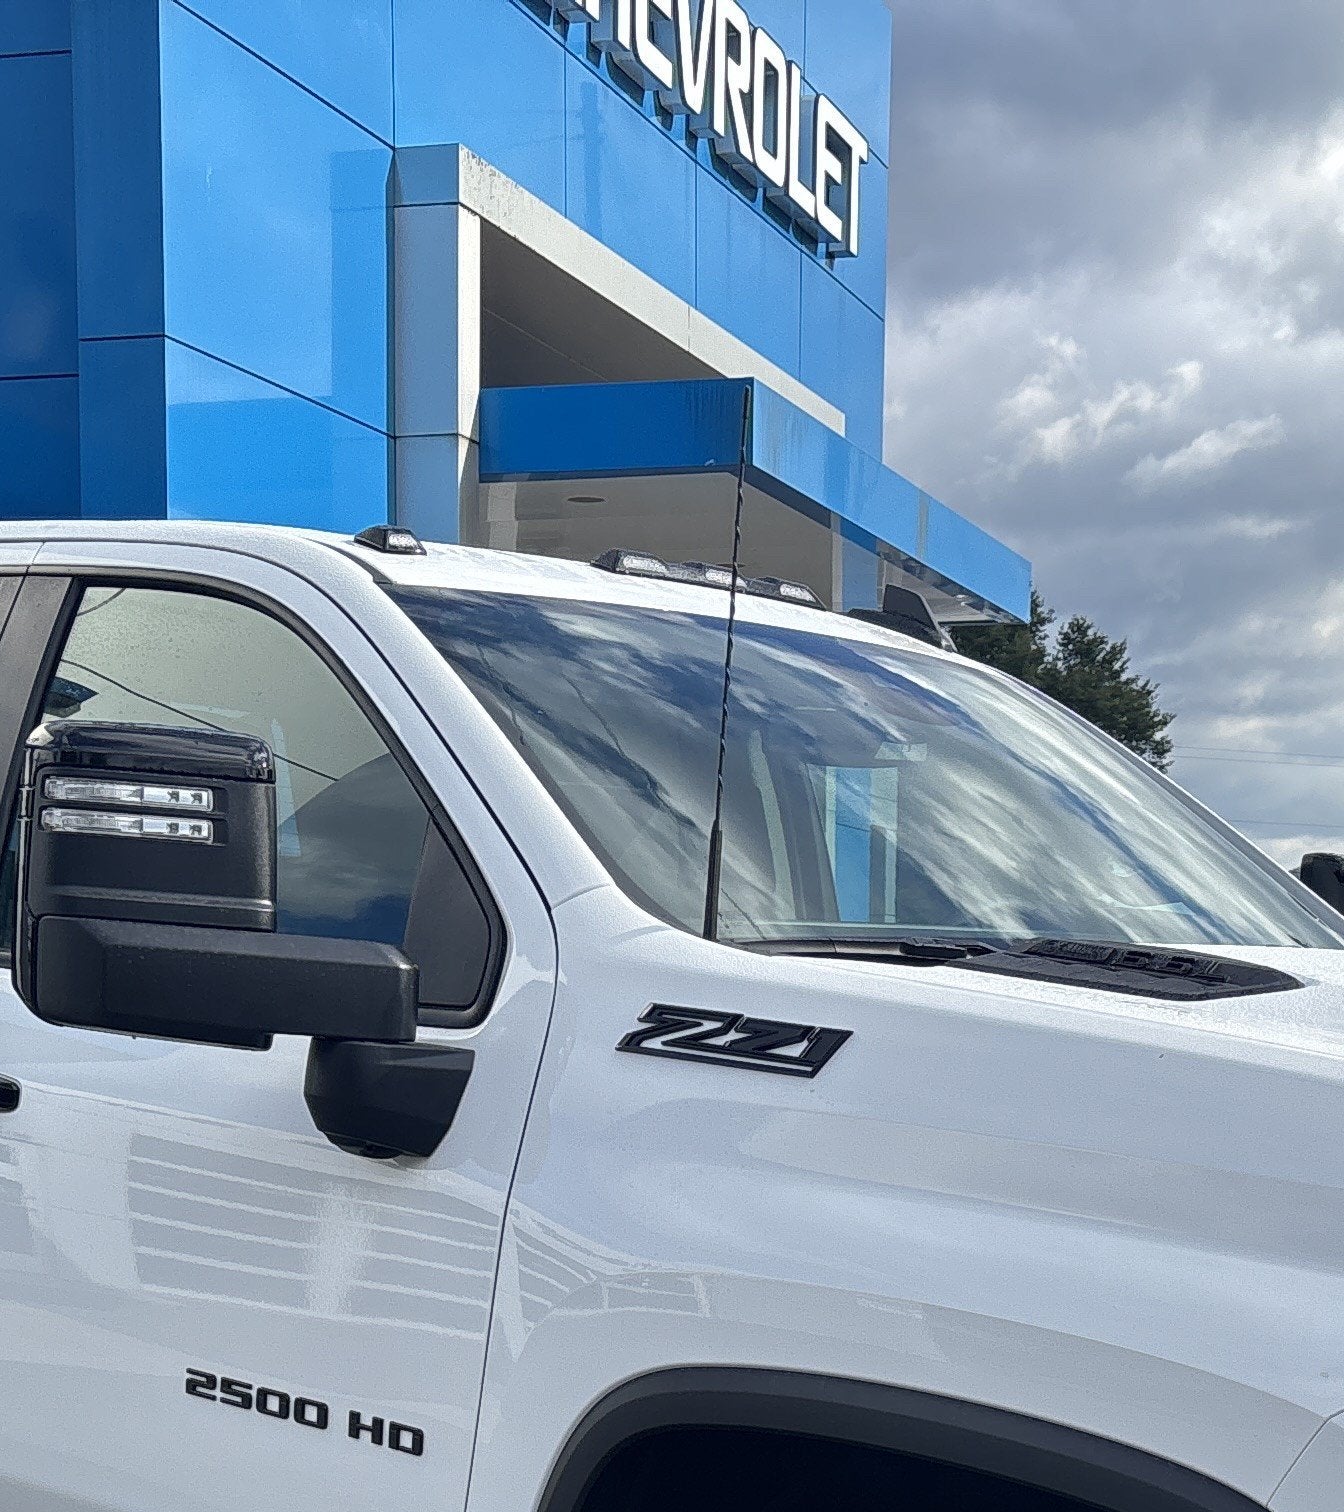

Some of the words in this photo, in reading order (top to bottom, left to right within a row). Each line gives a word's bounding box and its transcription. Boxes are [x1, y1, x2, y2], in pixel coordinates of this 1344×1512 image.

[581, 0, 868, 257] EVROLET
[185, 1367, 328, 1430] 2500
[348, 1410, 424, 1457] HD
